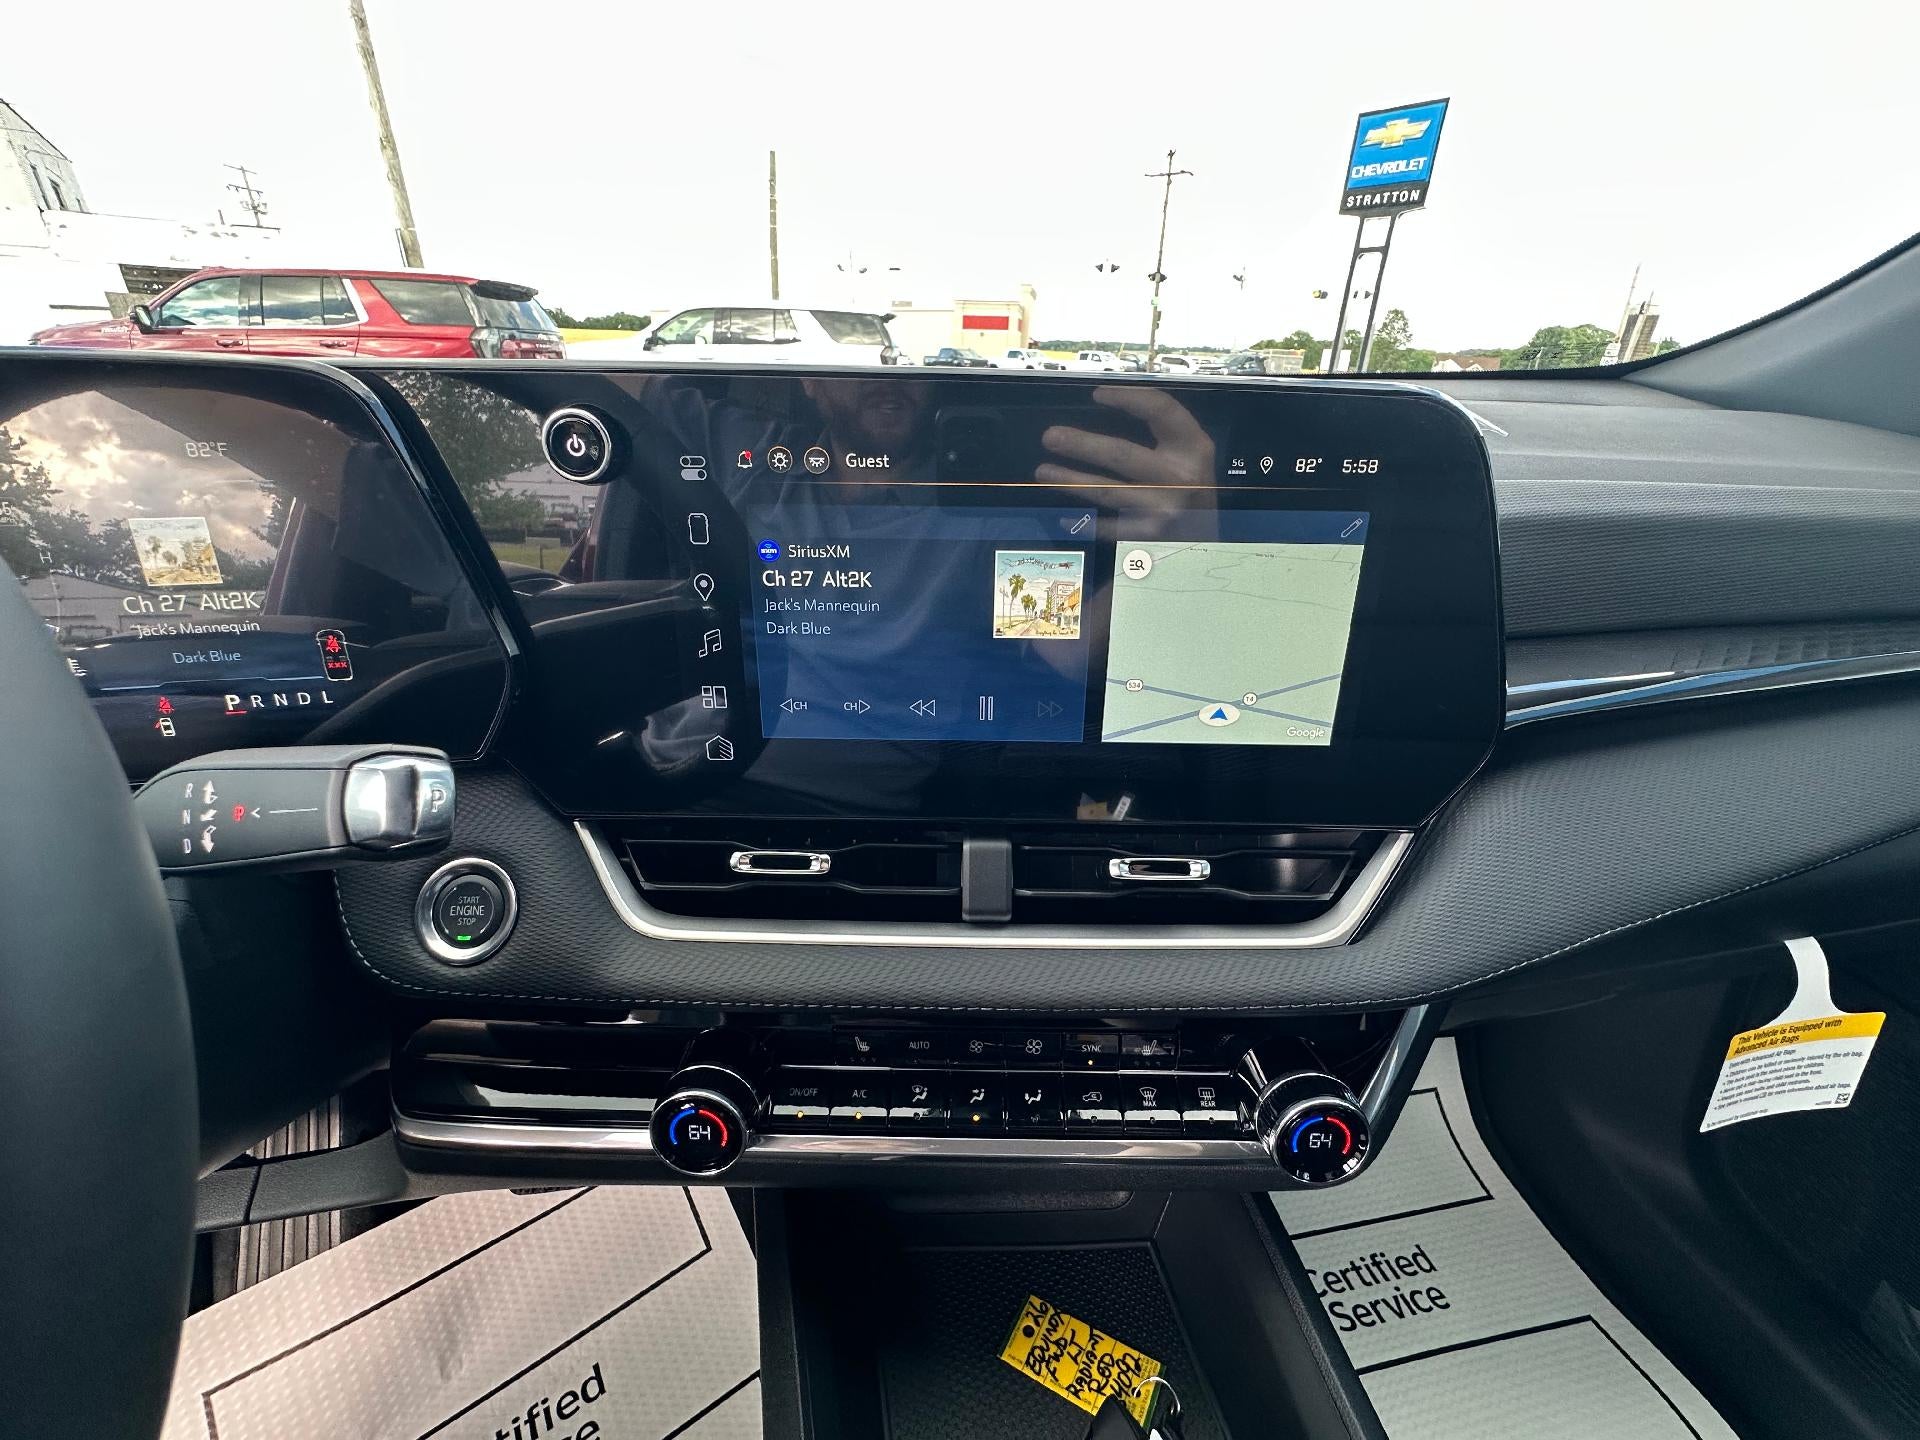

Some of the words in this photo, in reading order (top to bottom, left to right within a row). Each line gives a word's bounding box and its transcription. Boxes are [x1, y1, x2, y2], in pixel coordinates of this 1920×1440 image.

[1351, 156, 1428, 179] CHEVROLET
[1346, 189, 1421, 208] STRATTON
[185, 441, 228, 458] 82°F
[845, 452, 890, 468] Guest
[1231, 458, 1245, 467] 5G
[1295, 458, 1323, 473] 82°
[1342, 459, 1379, 474] 5:58
[788, 544, 850, 558] SiriusXM
[762, 569, 786, 587] Ch
[790, 570, 814, 587] 27
[822, 570, 872, 588] Alt2K
[122, 595, 154, 614] Ch
[159, 594, 186, 612] 27
[200, 591, 261, 611] Alt2K
[764, 597, 801, 613] Jack's
[804, 598, 880, 616] Mannequin
[137, 622, 177, 639] Jack's
[179, 620, 261, 635] Mannequin
[766, 621, 798, 634] Dark
[801, 621, 831, 635] Blue
[172, 651, 208, 664] Dark
[209, 650, 241, 662] Blue
[224, 694, 240, 711] P
[250, 695, 265, 708] R
[273, 693, 289, 707] N
[297, 692, 311, 705] D
[793, 701, 808, 710] CH
[843, 702, 858, 711] CH
[1286, 727, 1325, 739] Google
[184, 782, 194, 799] R
[430, 784, 447, 813] P
[182, 809, 192, 825] N
[232, 804, 246, 822] P
[183, 839, 192, 854] D
[458, 896, 480, 904] START
[449, 905, 485, 916] ENGINE
[457, 917, 476, 926] STOP
[1738, 1035, 1752, 1045] This
[1753, 1029, 1779, 1041] Vehicle
[1780, 1027, 1787, 1035] is
[1788, 1021, 1824, 1034] Equipped
[1824, 1019, 1843, 1028] with
[908, 1041, 930, 1050] AUTO
[1734, 1041, 1767, 1055] Advanced
[1767, 1037, 1779, 1046] Air
[1780, 1035, 1800, 1045] Bags
[789, 1087, 818, 1097] ON/OFF
[852, 1089, 867, 1099] A/C
[688, 1124, 710, 1140] 64
[1309, 1132, 1332, 1149] 64
[1026, 1300, 1050, 1328] 26
[1328, 1286, 1451, 1332] Service
[1025, 1308, 1065, 1376] EQUINOX
[1067, 1328, 1086, 1366] LT
[1066, 1328, 1104, 1400] RADIANT
[1110, 1351, 1143, 1400] 4092
